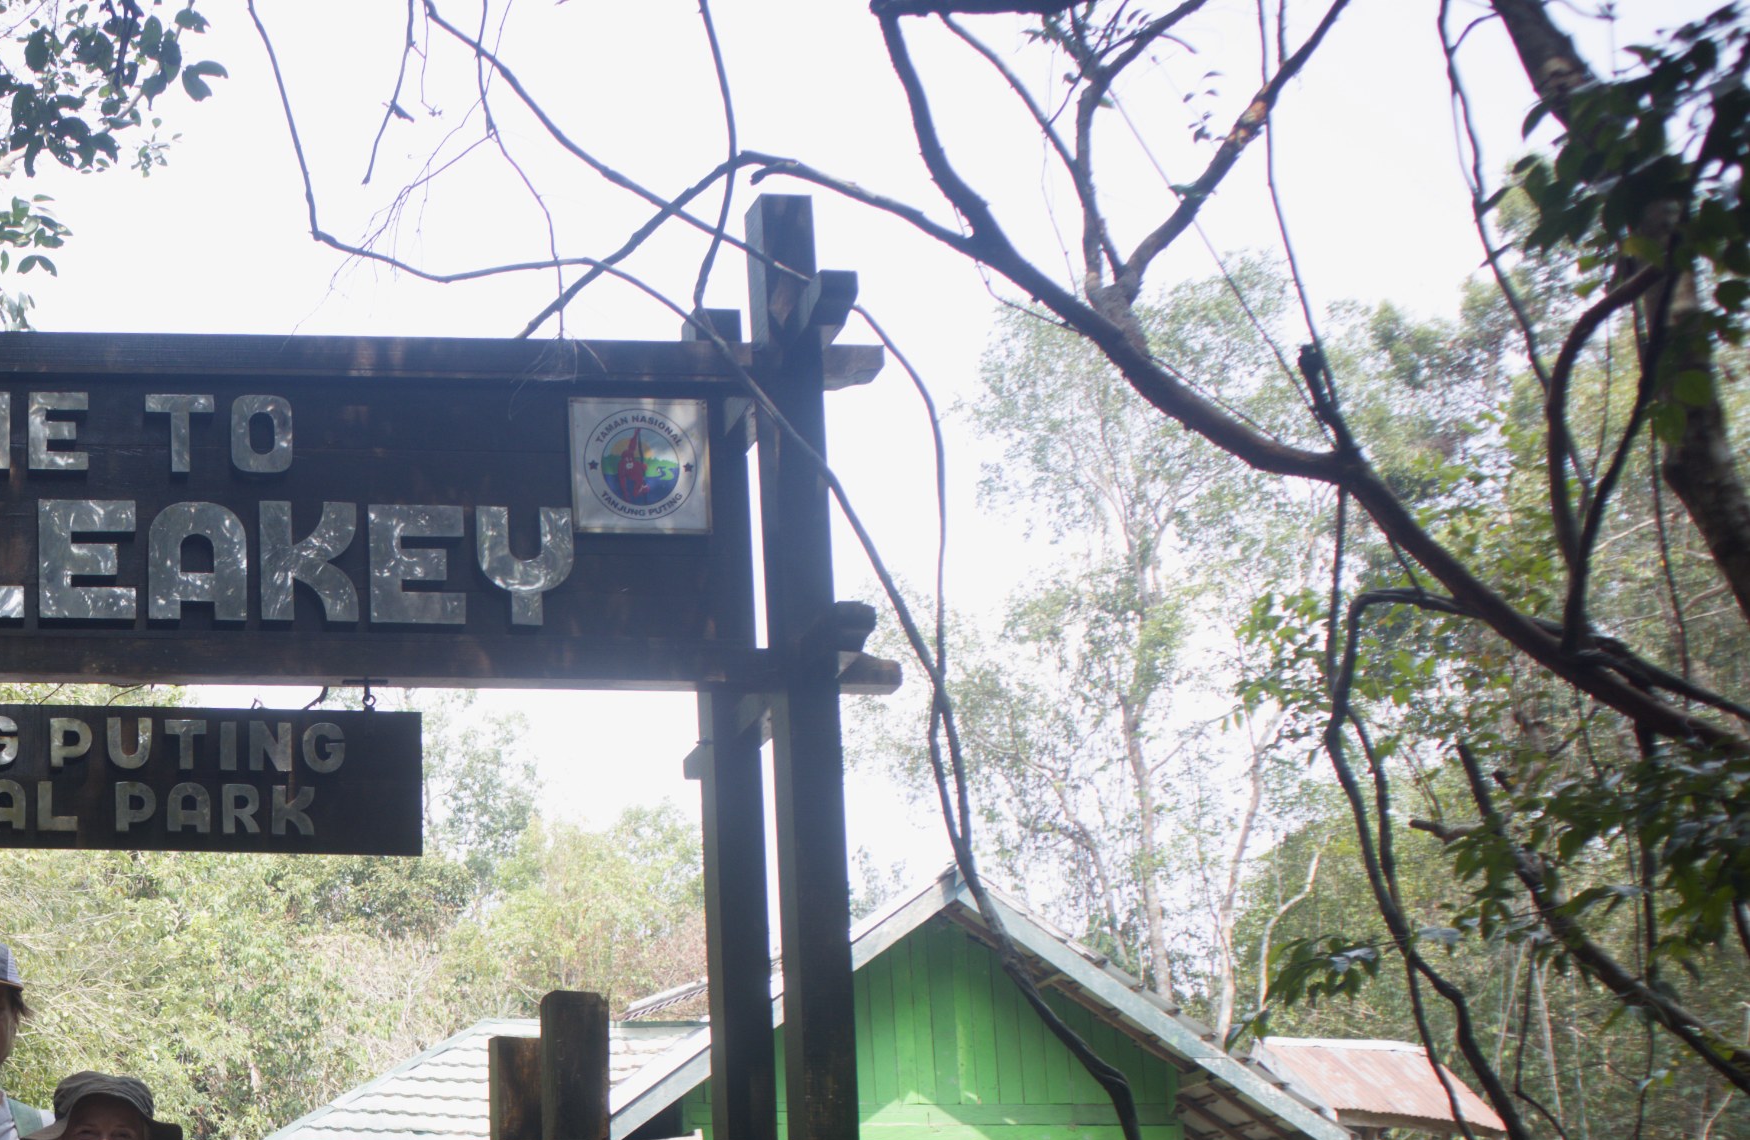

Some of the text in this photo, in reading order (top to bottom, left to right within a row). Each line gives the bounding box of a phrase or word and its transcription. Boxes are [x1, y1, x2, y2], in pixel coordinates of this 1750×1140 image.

[145, 393, 294, 474] TO
[595, 415, 684, 447] TAMAN NASIONAL
[601, 490, 683, 517] TANJUNG PUTING
[50, 716, 347, 774] PUTING
[115, 781, 316, 836] PARK
